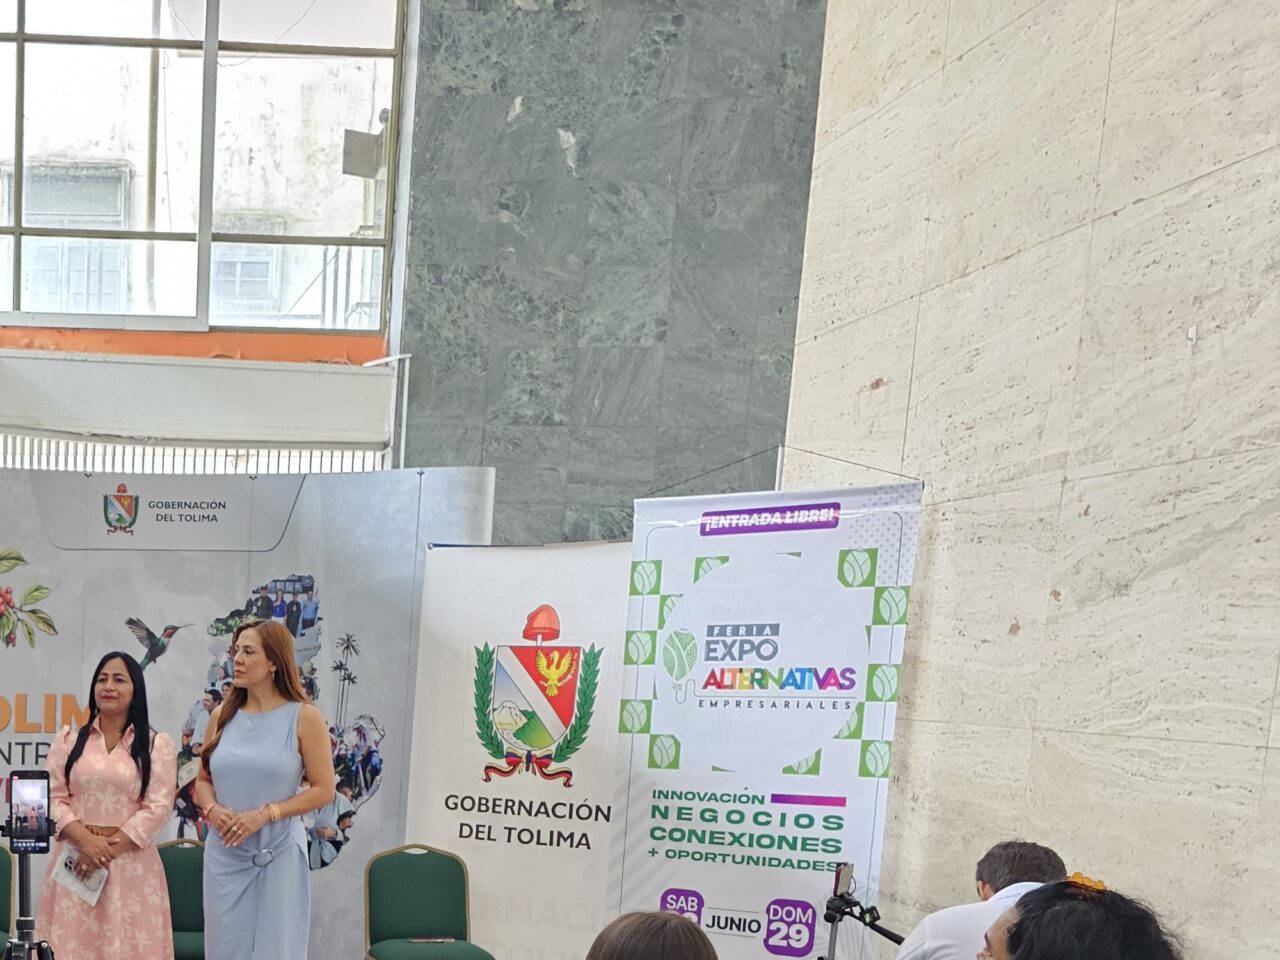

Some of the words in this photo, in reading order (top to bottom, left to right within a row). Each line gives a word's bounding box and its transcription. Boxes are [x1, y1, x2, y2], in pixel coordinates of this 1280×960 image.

[148, 499, 226, 510] GOBERNACIÓN
[156, 514, 175, 522] DEL
[178, 514, 218, 522] TOLIMA
[713, 626, 771, 637] FERIA
[704, 638, 779, 661] EXPO
[701, 667, 857, 690] ALTERNATIVAS
[698, 699, 852, 710] EMPRESARIALES
[652, 787, 765, 805] INNOVACIÓN
[444, 794, 612, 822] GOBERNACIÓN
[650, 804, 845, 831] NEGOCIOS
[458, 822, 497, 843] DEL
[504, 826, 592, 850] TOLIMA
[649, 826, 843, 854] CONEXIONES
[665, 849, 837, 872] OPORTUNIDADES
[666, 894, 698, 912] SAB
[705, 915, 762, 933] JUNIO
[769, 905, 813, 924] DOM
[768, 921, 810, 949] 29
